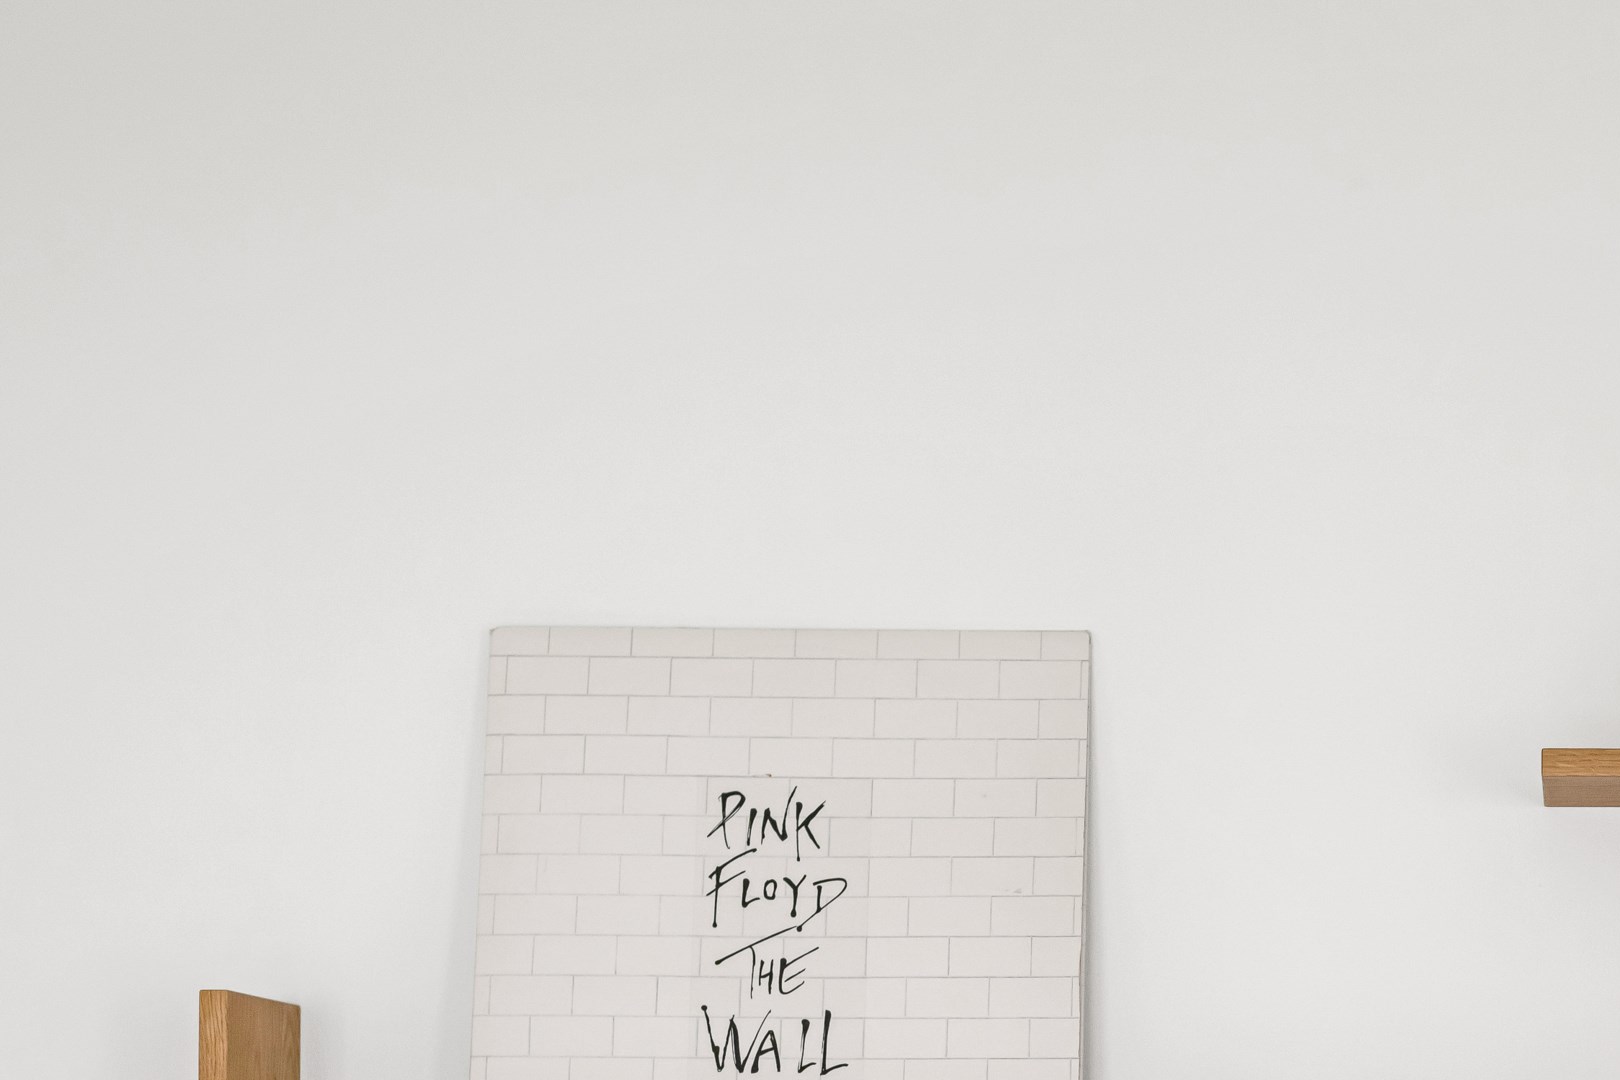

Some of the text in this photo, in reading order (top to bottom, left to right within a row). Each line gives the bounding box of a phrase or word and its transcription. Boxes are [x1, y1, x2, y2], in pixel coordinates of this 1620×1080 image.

[706, 786, 827, 862] PINK
[706, 847, 848, 933] FLOYD
[714, 925, 820, 1000] THE
[700, 1004, 849, 1076] WALL
